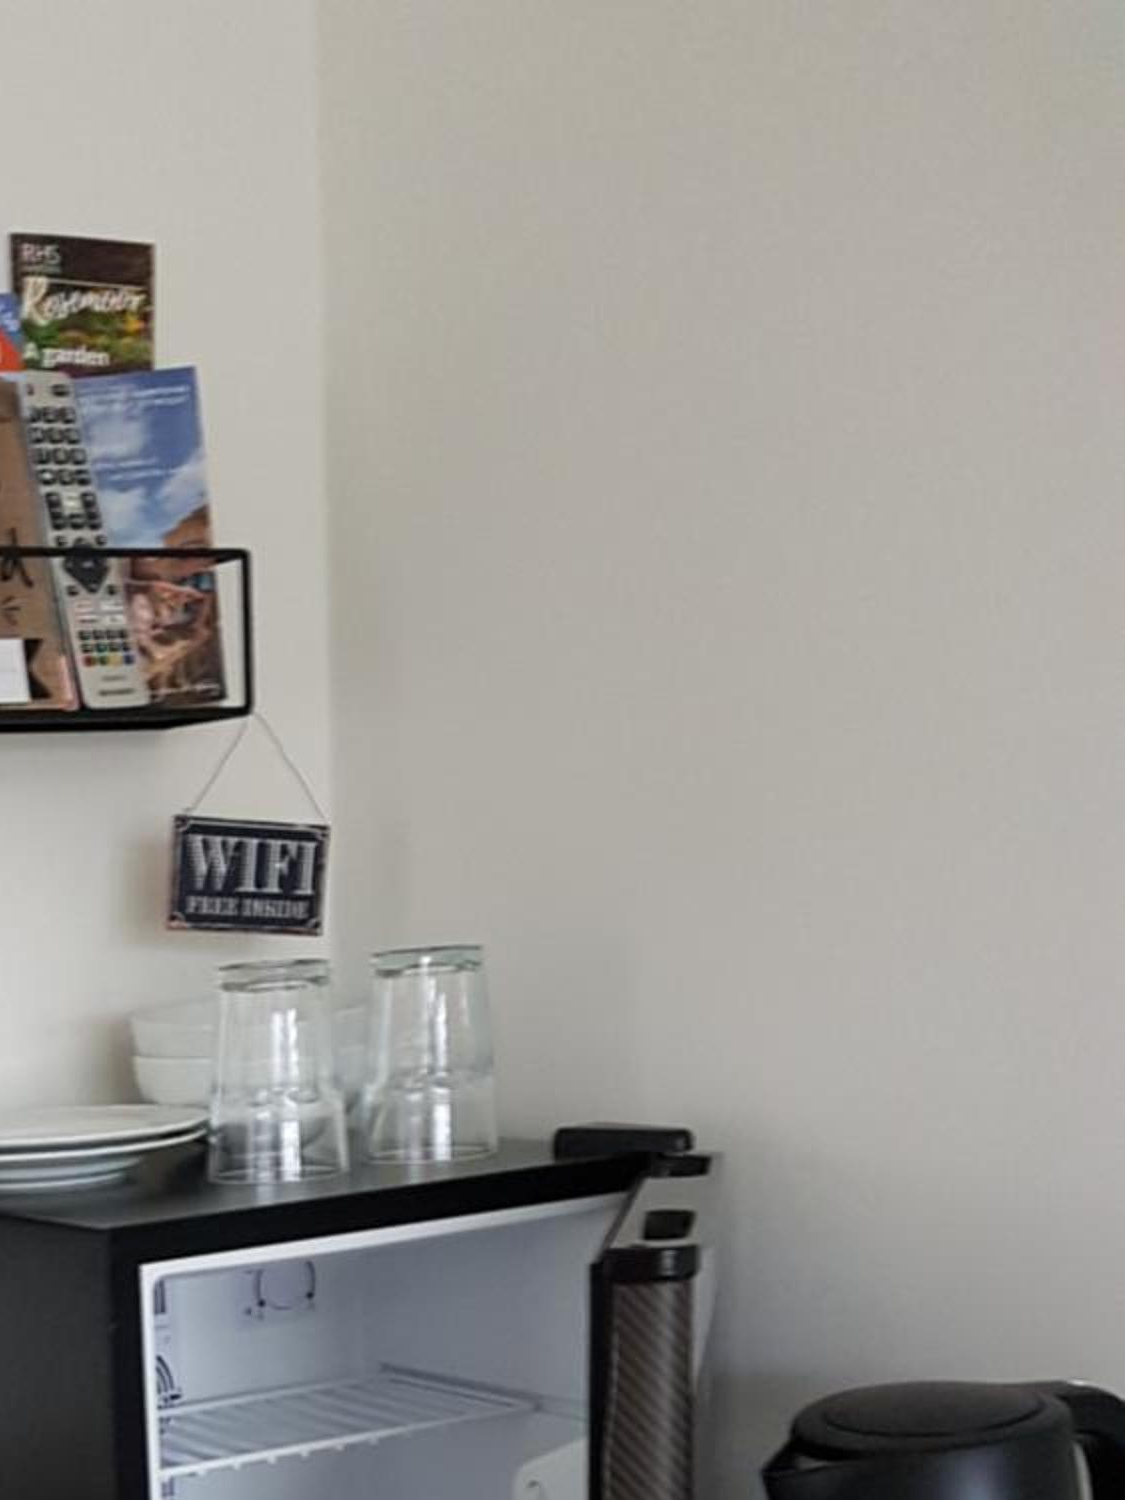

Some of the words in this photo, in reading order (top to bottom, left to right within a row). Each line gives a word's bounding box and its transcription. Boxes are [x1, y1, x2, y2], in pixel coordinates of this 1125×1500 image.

[22, 243, 62, 264] RHS
[23, 341, 40, 360] A
[41, 344, 110, 368] garden
[186, 833, 317, 896] WIFI
[185, 895, 238, 915] FREE
[241, 898, 310, 919] INSIDE
